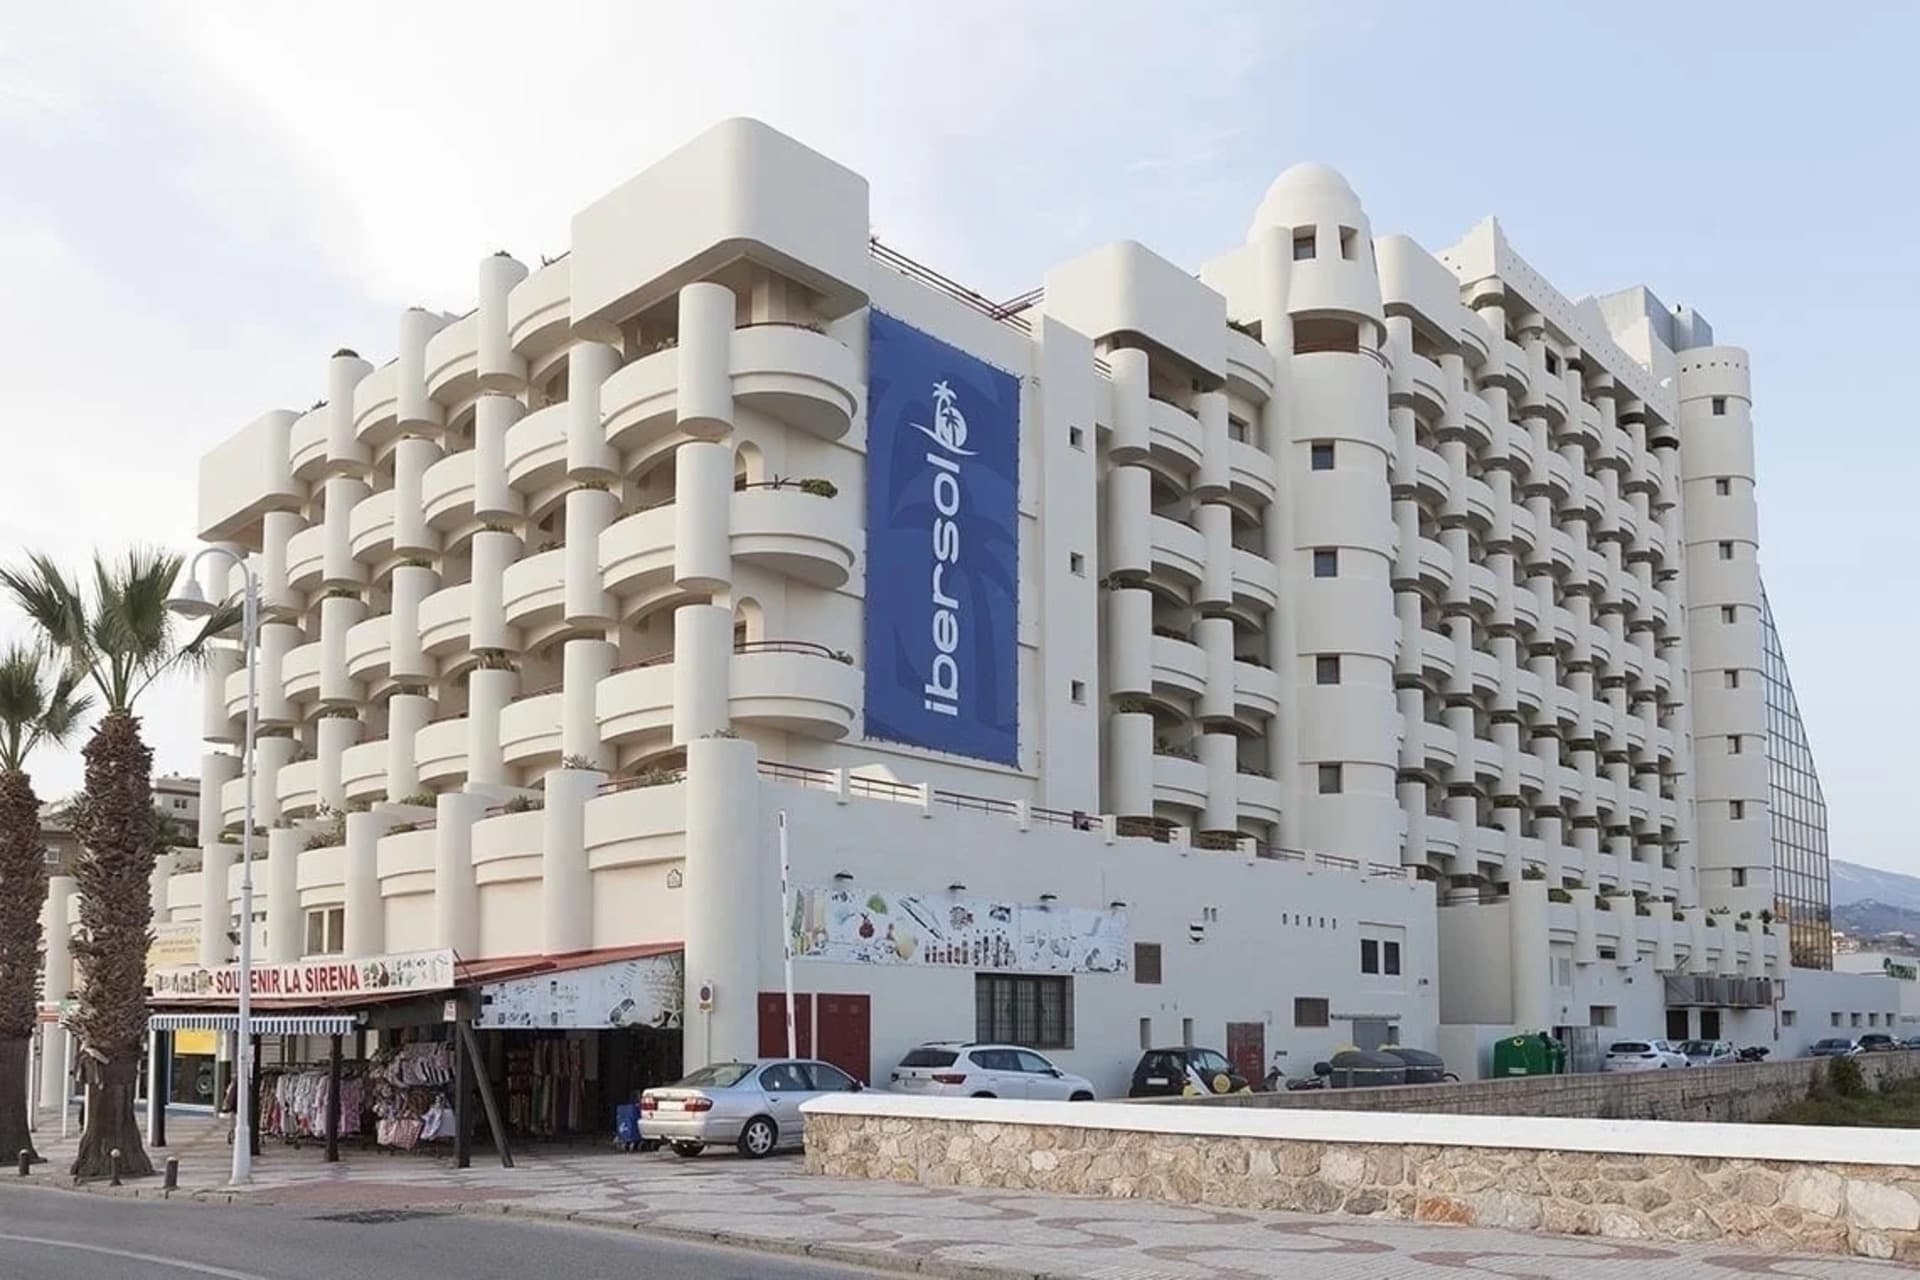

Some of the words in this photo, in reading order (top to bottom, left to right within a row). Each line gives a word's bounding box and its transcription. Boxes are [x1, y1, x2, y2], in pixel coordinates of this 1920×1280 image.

[925, 452, 960, 716] ibersol
[216, 969, 281, 994] SOUENIR
[284, 969, 301, 993] LA
[305, 964, 360, 991] SIRENA
